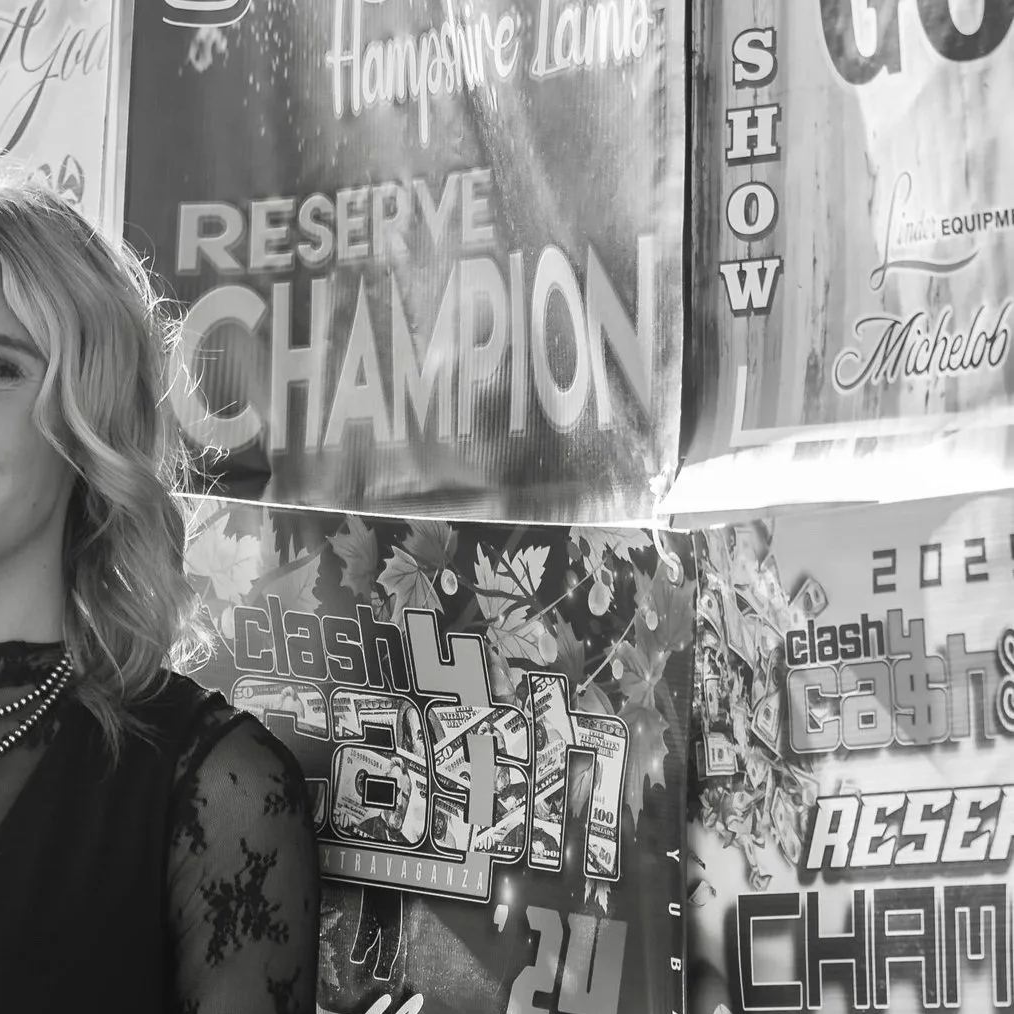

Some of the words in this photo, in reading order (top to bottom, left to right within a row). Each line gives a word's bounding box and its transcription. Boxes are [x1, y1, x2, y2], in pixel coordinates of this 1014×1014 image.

[719, 27, 783, 317] SHOW
[176, 168, 494, 275] RESERVE
[941, 209, 1014, 236] EQUIPM
[170, 235, 655, 452] CHAMPION
[834, 302, 1012, 390] Michelob
[872, 534, 1014, 594] 202
[234, 595, 410, 692] clash
[786, 612, 886, 667] clash
[593, 806, 614, 825] 100
[322, 848, 484, 891] XTRAVAGANZA
